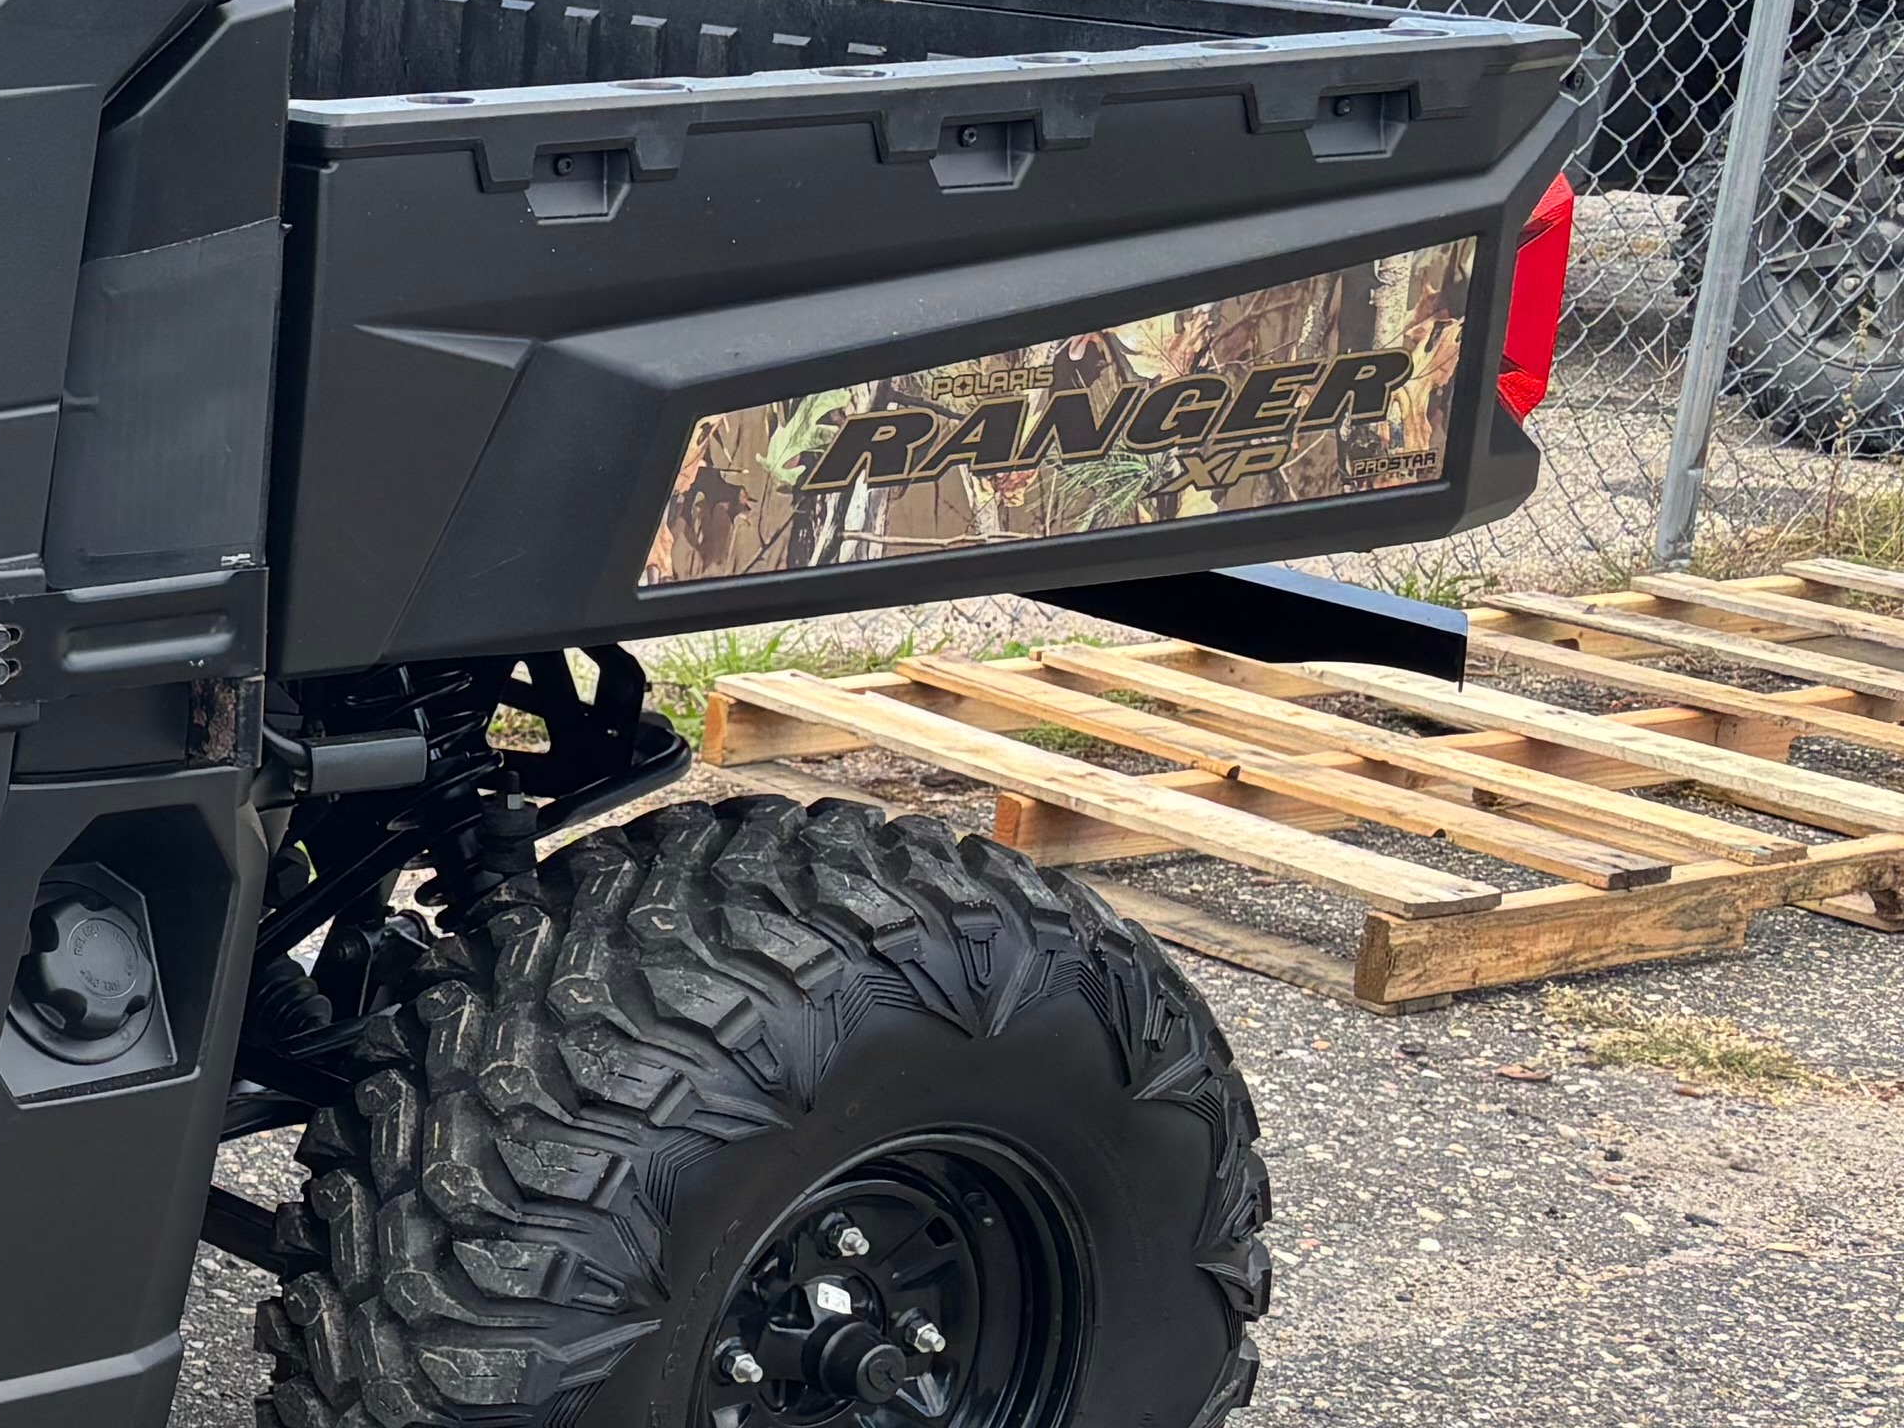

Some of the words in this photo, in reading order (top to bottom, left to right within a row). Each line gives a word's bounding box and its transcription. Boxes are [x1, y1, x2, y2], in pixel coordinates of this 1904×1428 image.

[931, 364, 1055, 400] POLARIS
[801, 347, 1415, 491] RANGER
[1159, 444, 1290, 492] XP
[1353, 450, 1438, 477] PROSTAR
